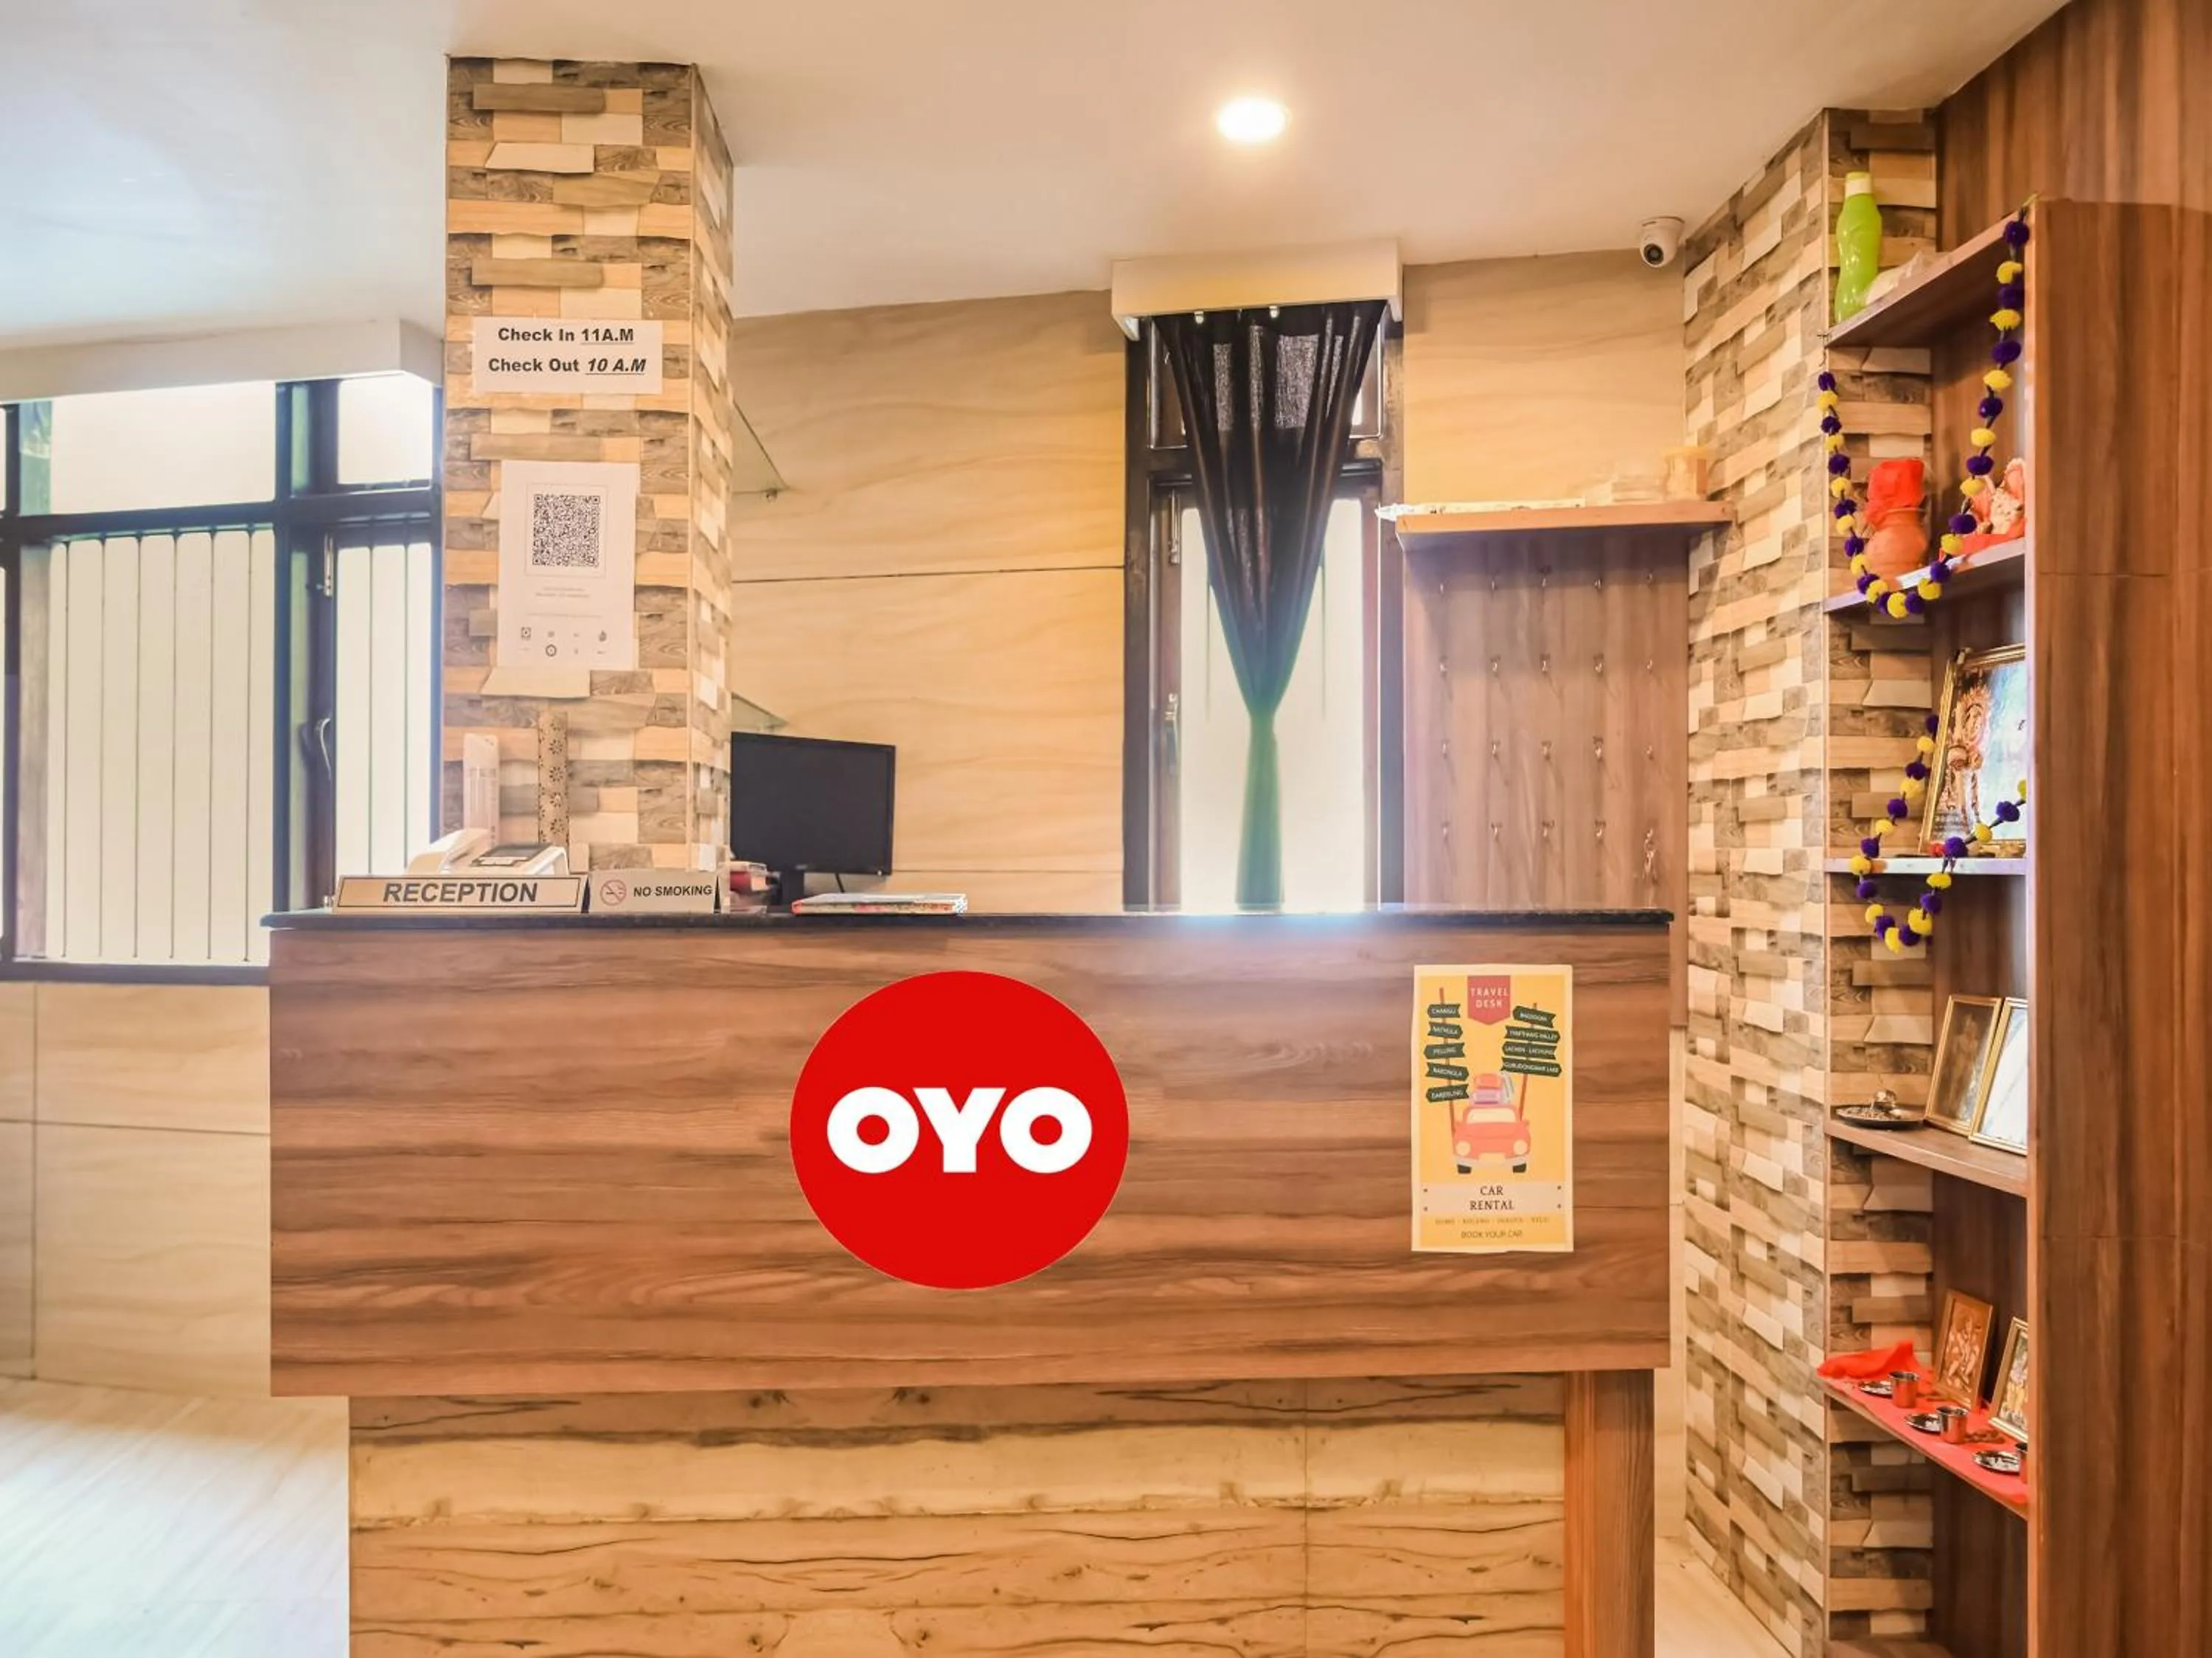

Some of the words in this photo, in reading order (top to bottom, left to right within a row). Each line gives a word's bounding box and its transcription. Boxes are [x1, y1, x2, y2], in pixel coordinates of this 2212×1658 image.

[498, 327, 553, 341] Check
[558, 328, 575, 341] In
[581, 328, 634, 341] 11A.M
[488, 358, 543, 372] Check
[549, 358, 580, 372] Out
[588, 358, 608, 372] 10
[613, 358, 647, 372] A.M
[383, 882, 538, 903] RECEPTION
[633, 886, 653, 897] NO
[655, 884, 713, 897] SMOKING
[1470, 987, 1509, 996] TRAVEL
[1475, 999, 1503, 1008] DESK
[827, 1086, 1093, 1174] OYO
[1480, 1185, 1503, 1196] CAR
[1470, 1200, 1515, 1211] RENTAL
[1461, 1231, 1485, 1239] BOOK
